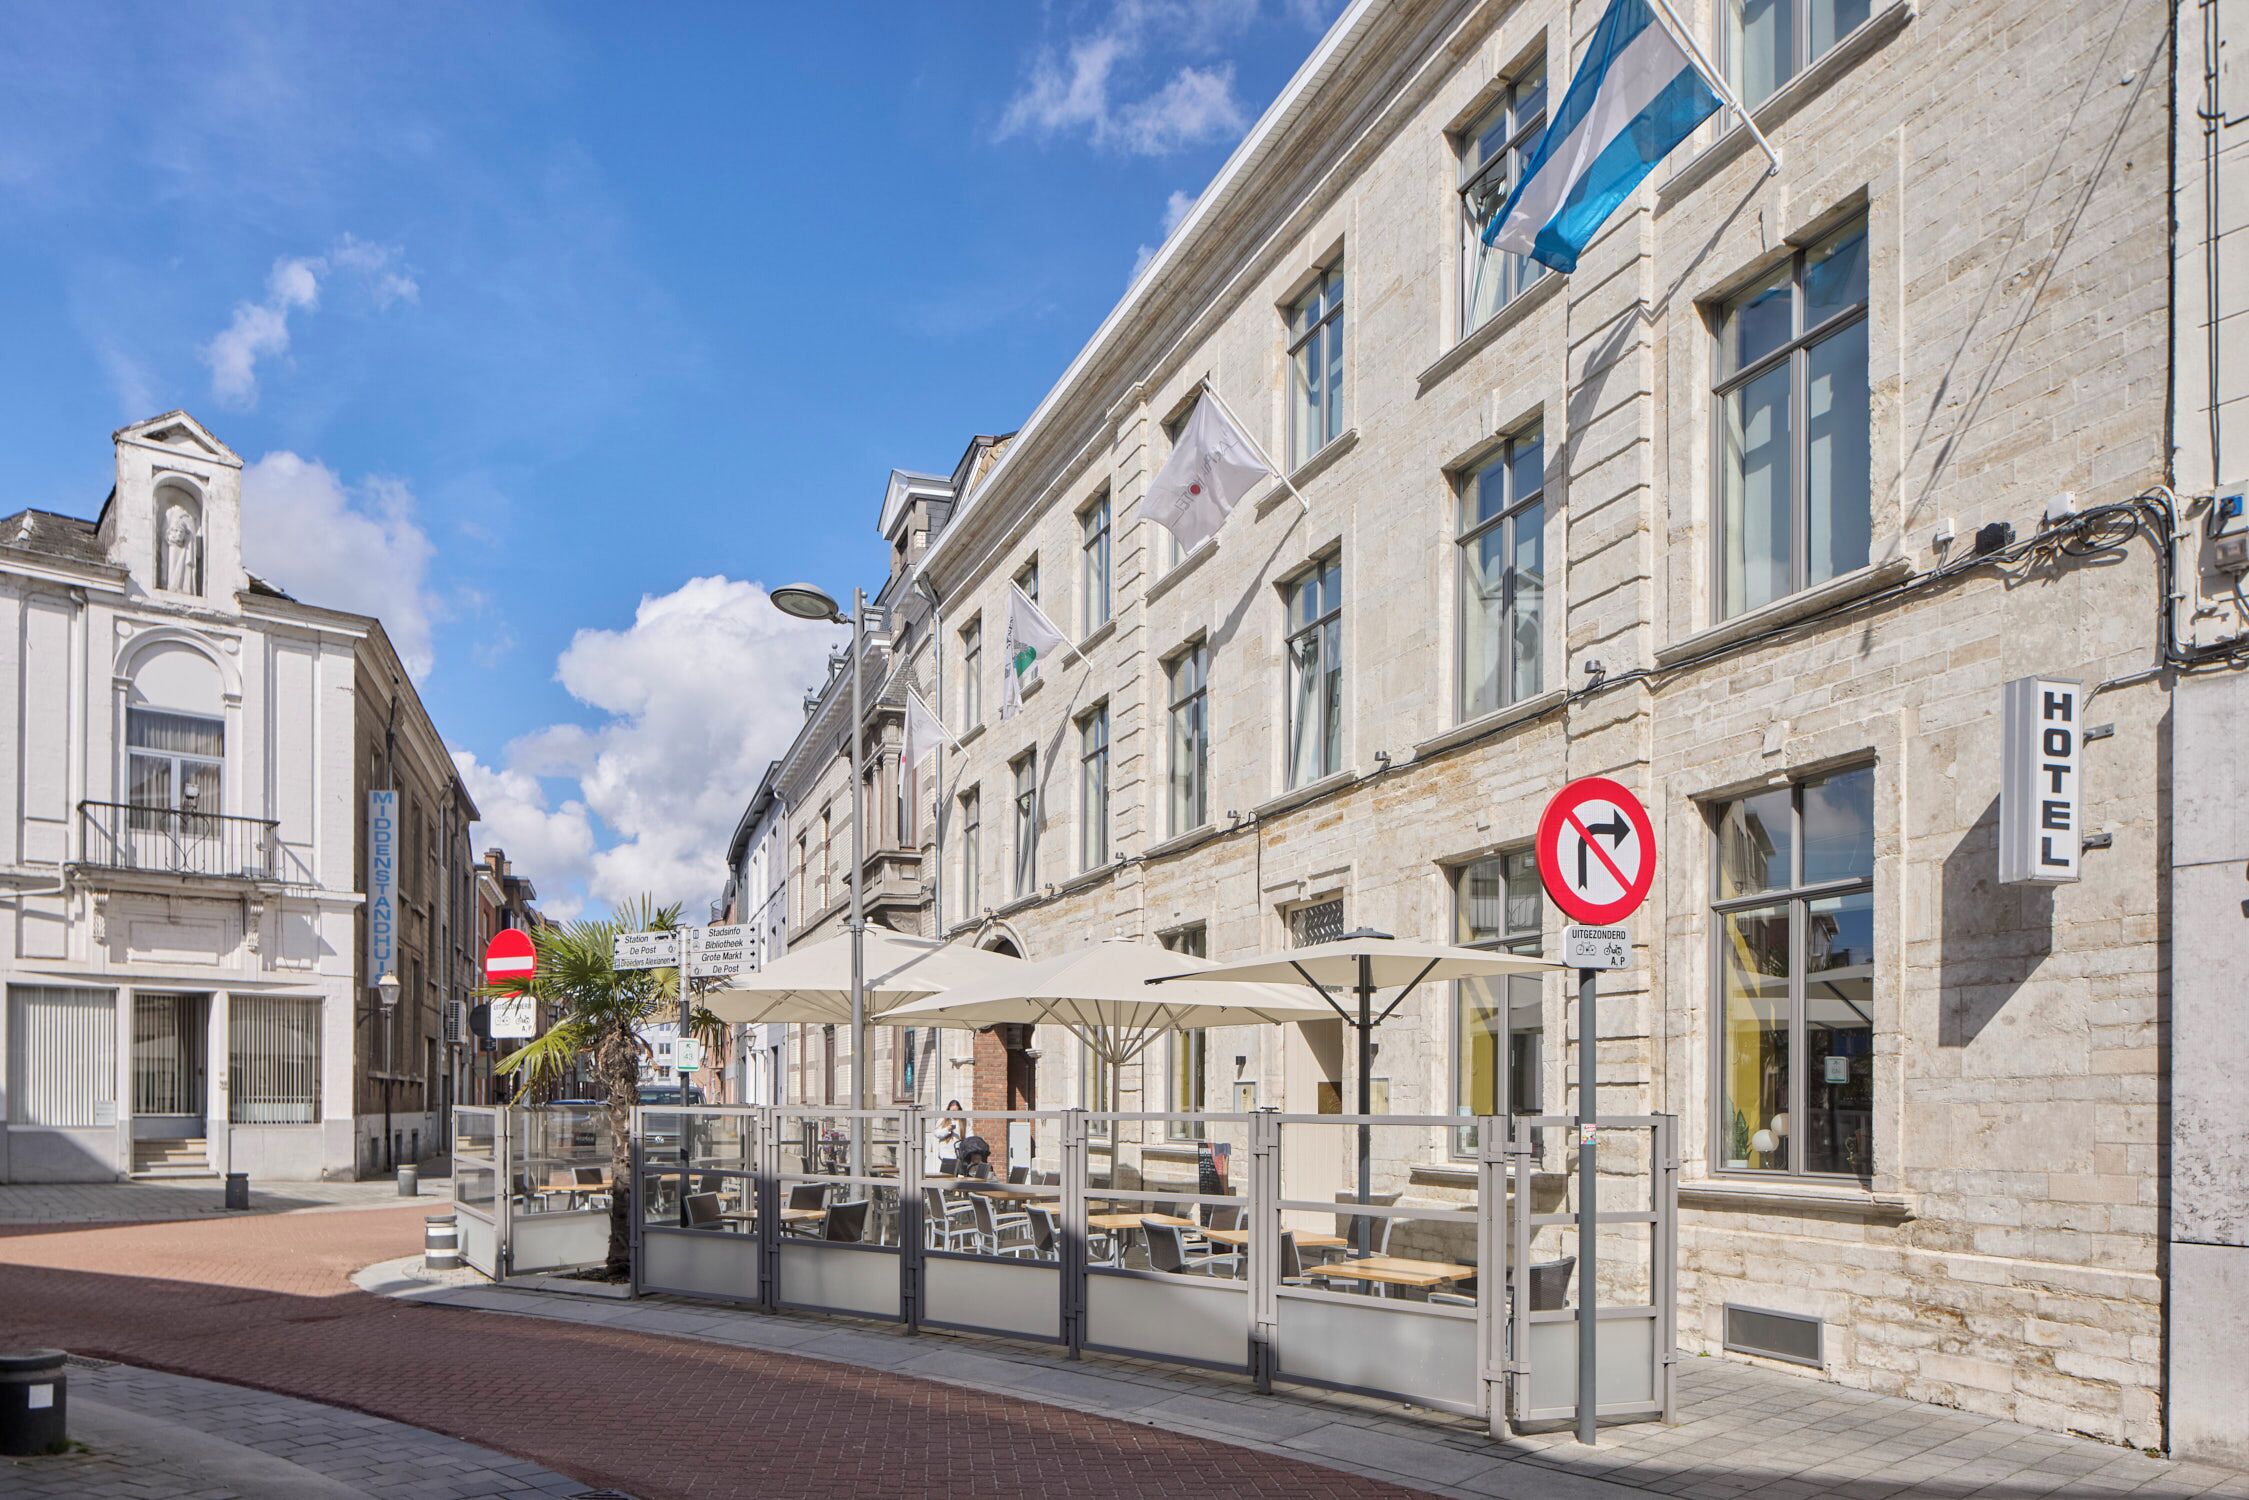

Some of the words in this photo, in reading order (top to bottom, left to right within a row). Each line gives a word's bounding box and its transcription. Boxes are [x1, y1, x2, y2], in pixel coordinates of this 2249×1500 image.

[2041, 691, 2072, 867] HOTEL
[708, 927, 741, 938] Stadsinfo
[1572, 929, 1626, 940] UITGEZONDERD
[624, 935, 649, 944] Station
[705, 939, 744, 950] Bibliotheek
[630, 947, 640, 955] De
[641, 946, 657, 954] Post
[701, 953, 721, 962] Grote
[722, 951, 742, 961] Markt
[1620, 956, 1626, 966] P
[712, 965, 722, 973] De
[723, 964, 739, 973] Post
